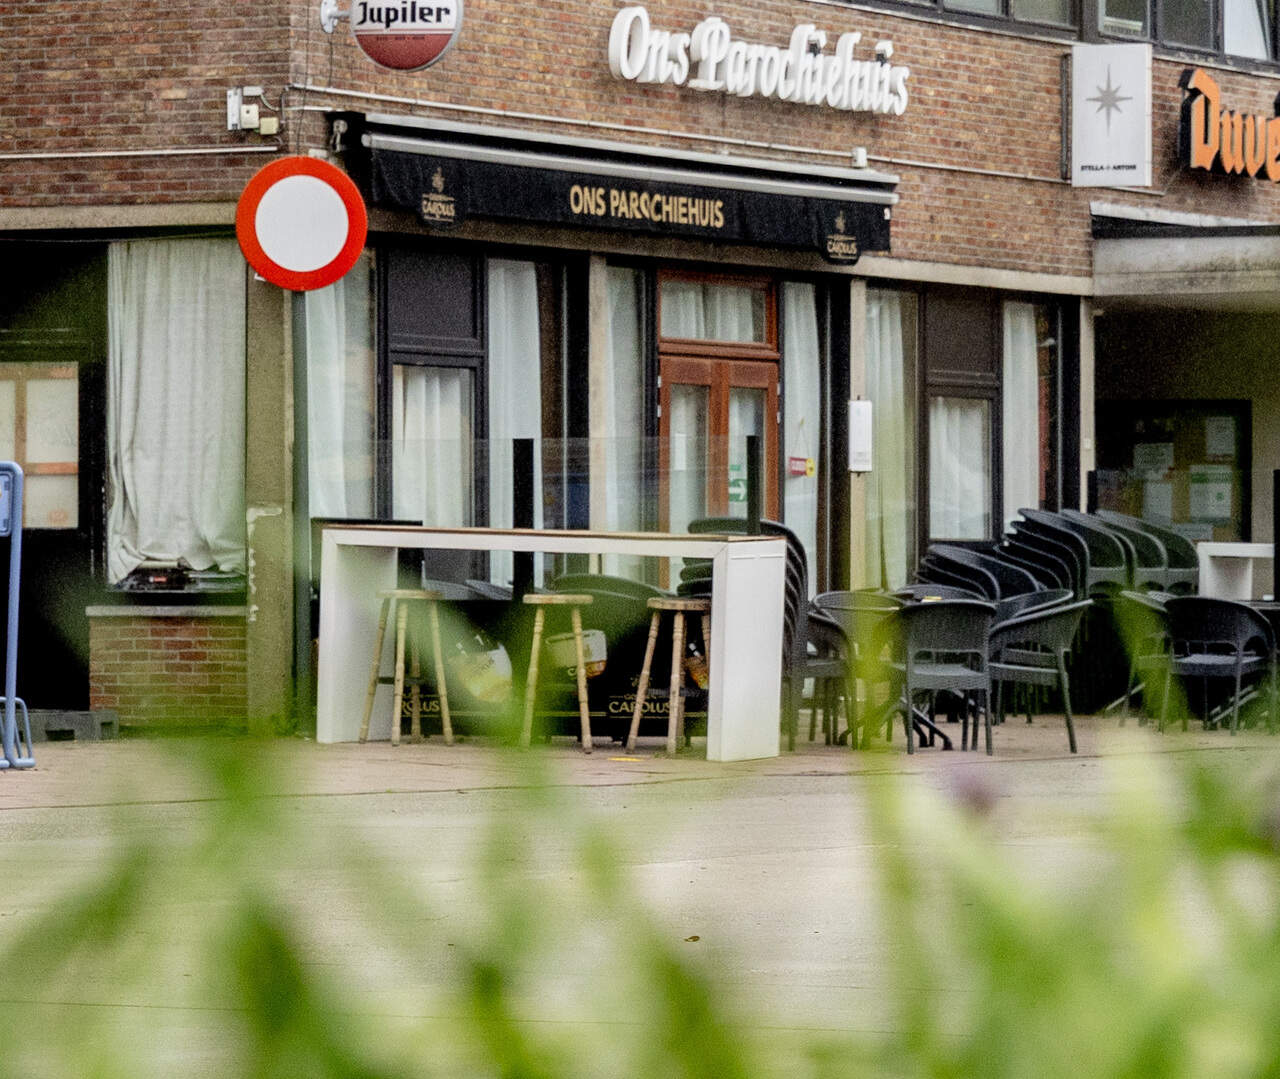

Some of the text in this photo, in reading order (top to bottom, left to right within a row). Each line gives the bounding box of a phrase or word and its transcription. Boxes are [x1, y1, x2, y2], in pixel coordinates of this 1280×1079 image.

[356, 0, 451, 29] Jupiler
[608, 6, 911, 116] Ons Parochiehuis
[570, 184, 607, 217] ONS
